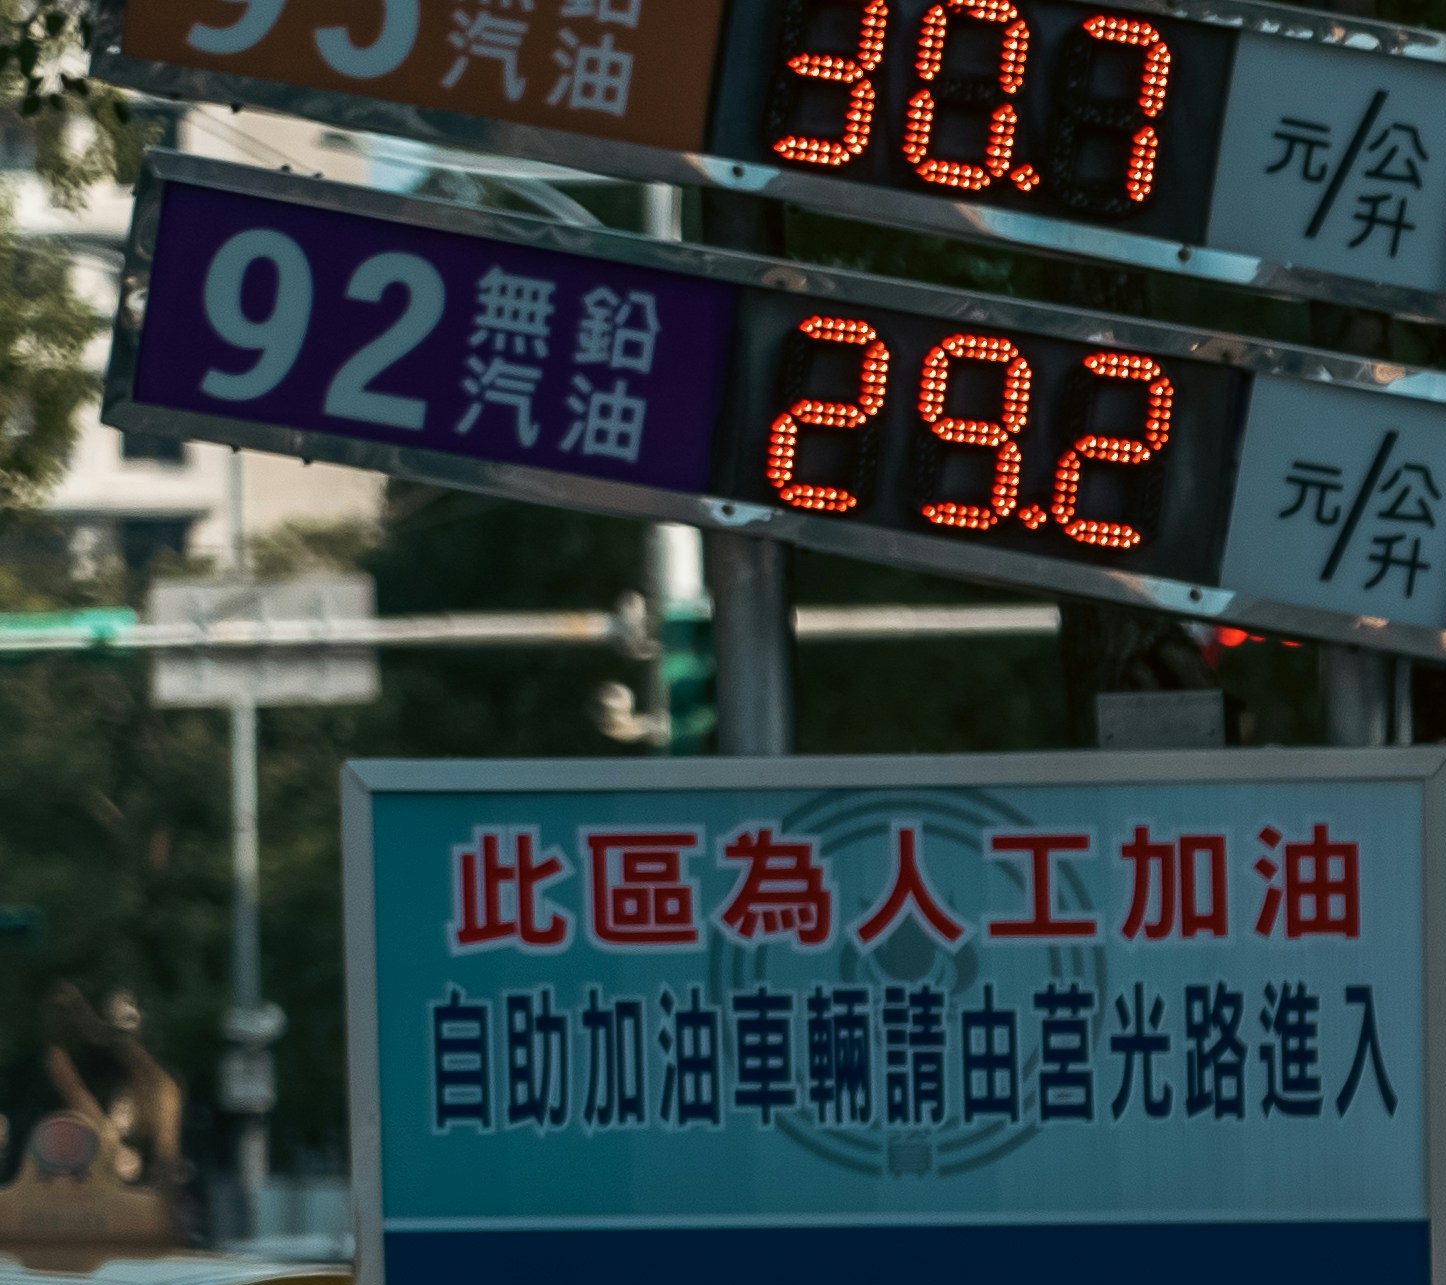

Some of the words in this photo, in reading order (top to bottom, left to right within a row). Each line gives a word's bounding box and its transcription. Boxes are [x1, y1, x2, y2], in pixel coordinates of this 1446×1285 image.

[442, 13, 633, 117] 汽油
[773, 0, 1171, 201] 30.7
[200, 229, 446, 431] 92
[470, 266, 661, 375] 無鉛
[456, 357, 647, 464] 汽油
[767, 316, 1174, 549] 29.2
[450, 823, 1361, 948] 此區為人工加油
[431, 983, 1399, 1131] 自助加油車輛請由莒光路進入
